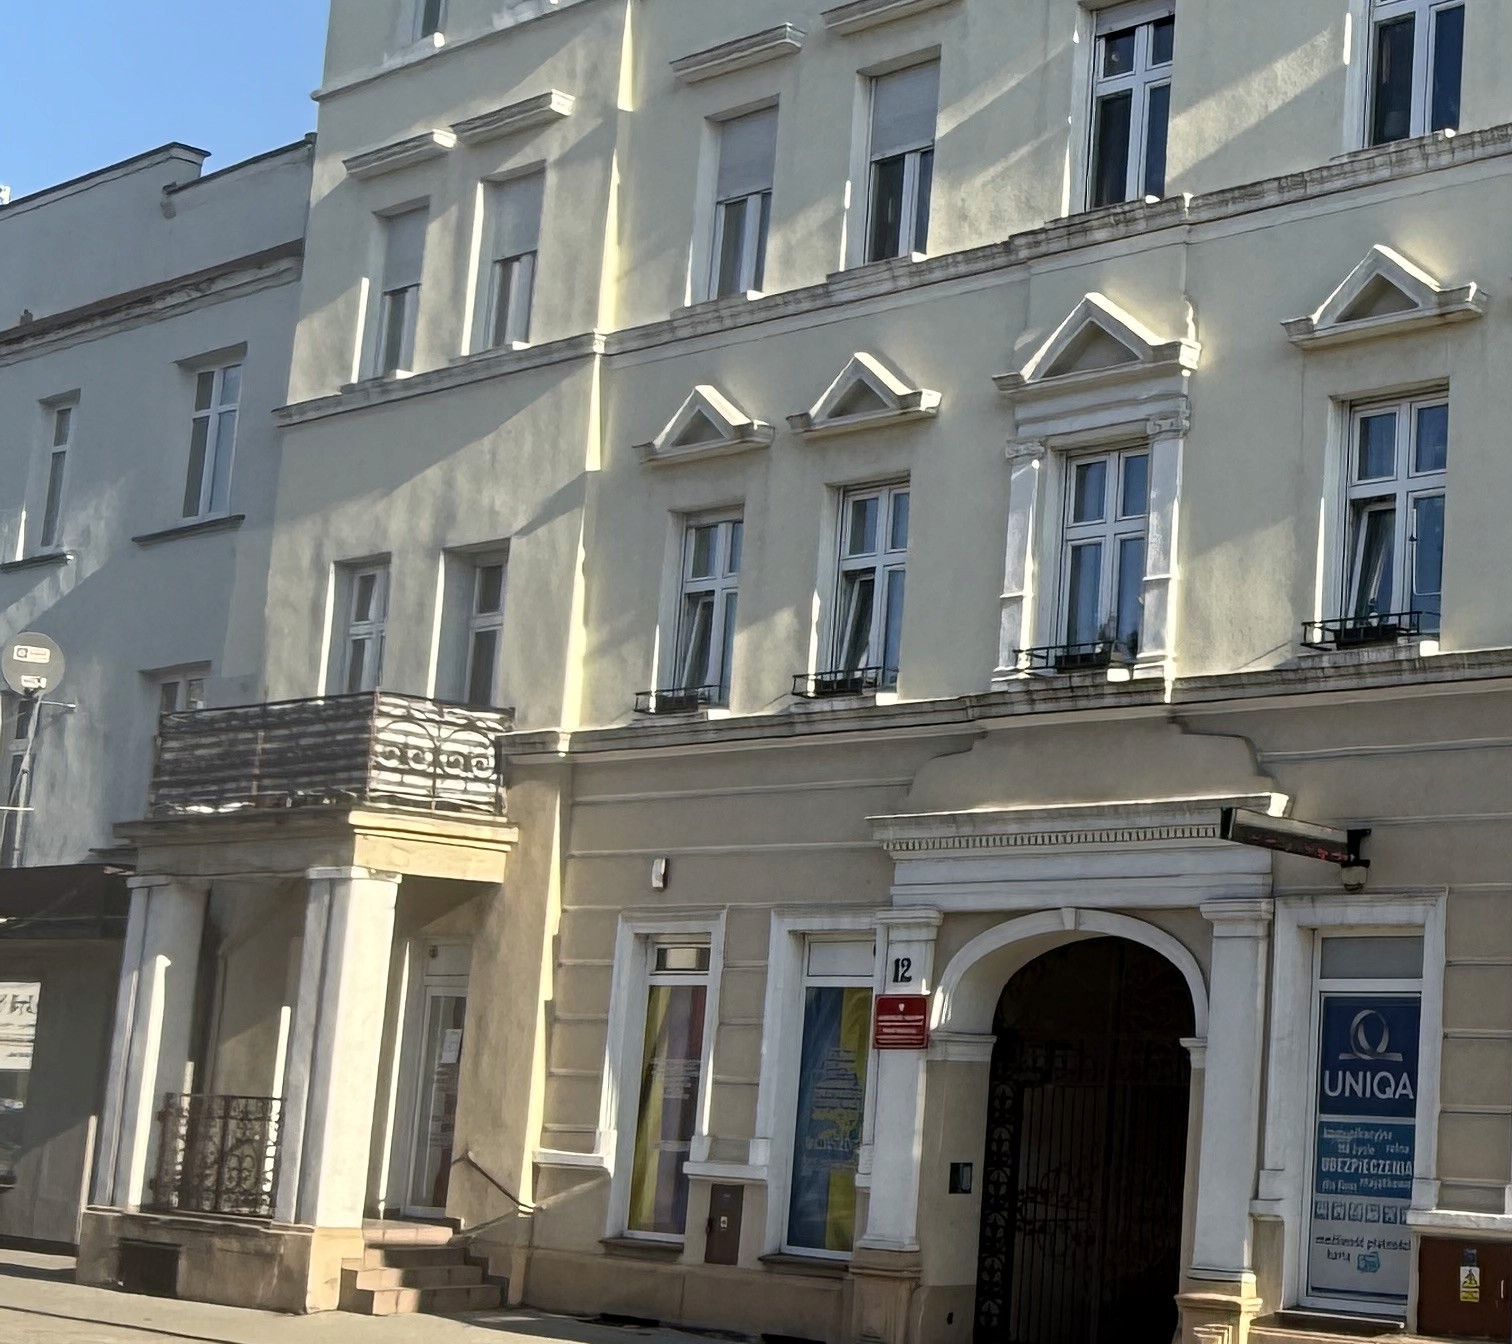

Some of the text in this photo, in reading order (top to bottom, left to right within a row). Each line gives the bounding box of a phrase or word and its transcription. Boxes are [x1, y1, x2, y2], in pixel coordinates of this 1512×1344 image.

[893, 957, 912, 983] 12
[1324, 1070, 1414, 1099] UNIQA
[1321, 1157, 1413, 1176] UBEZPIECZENIA
